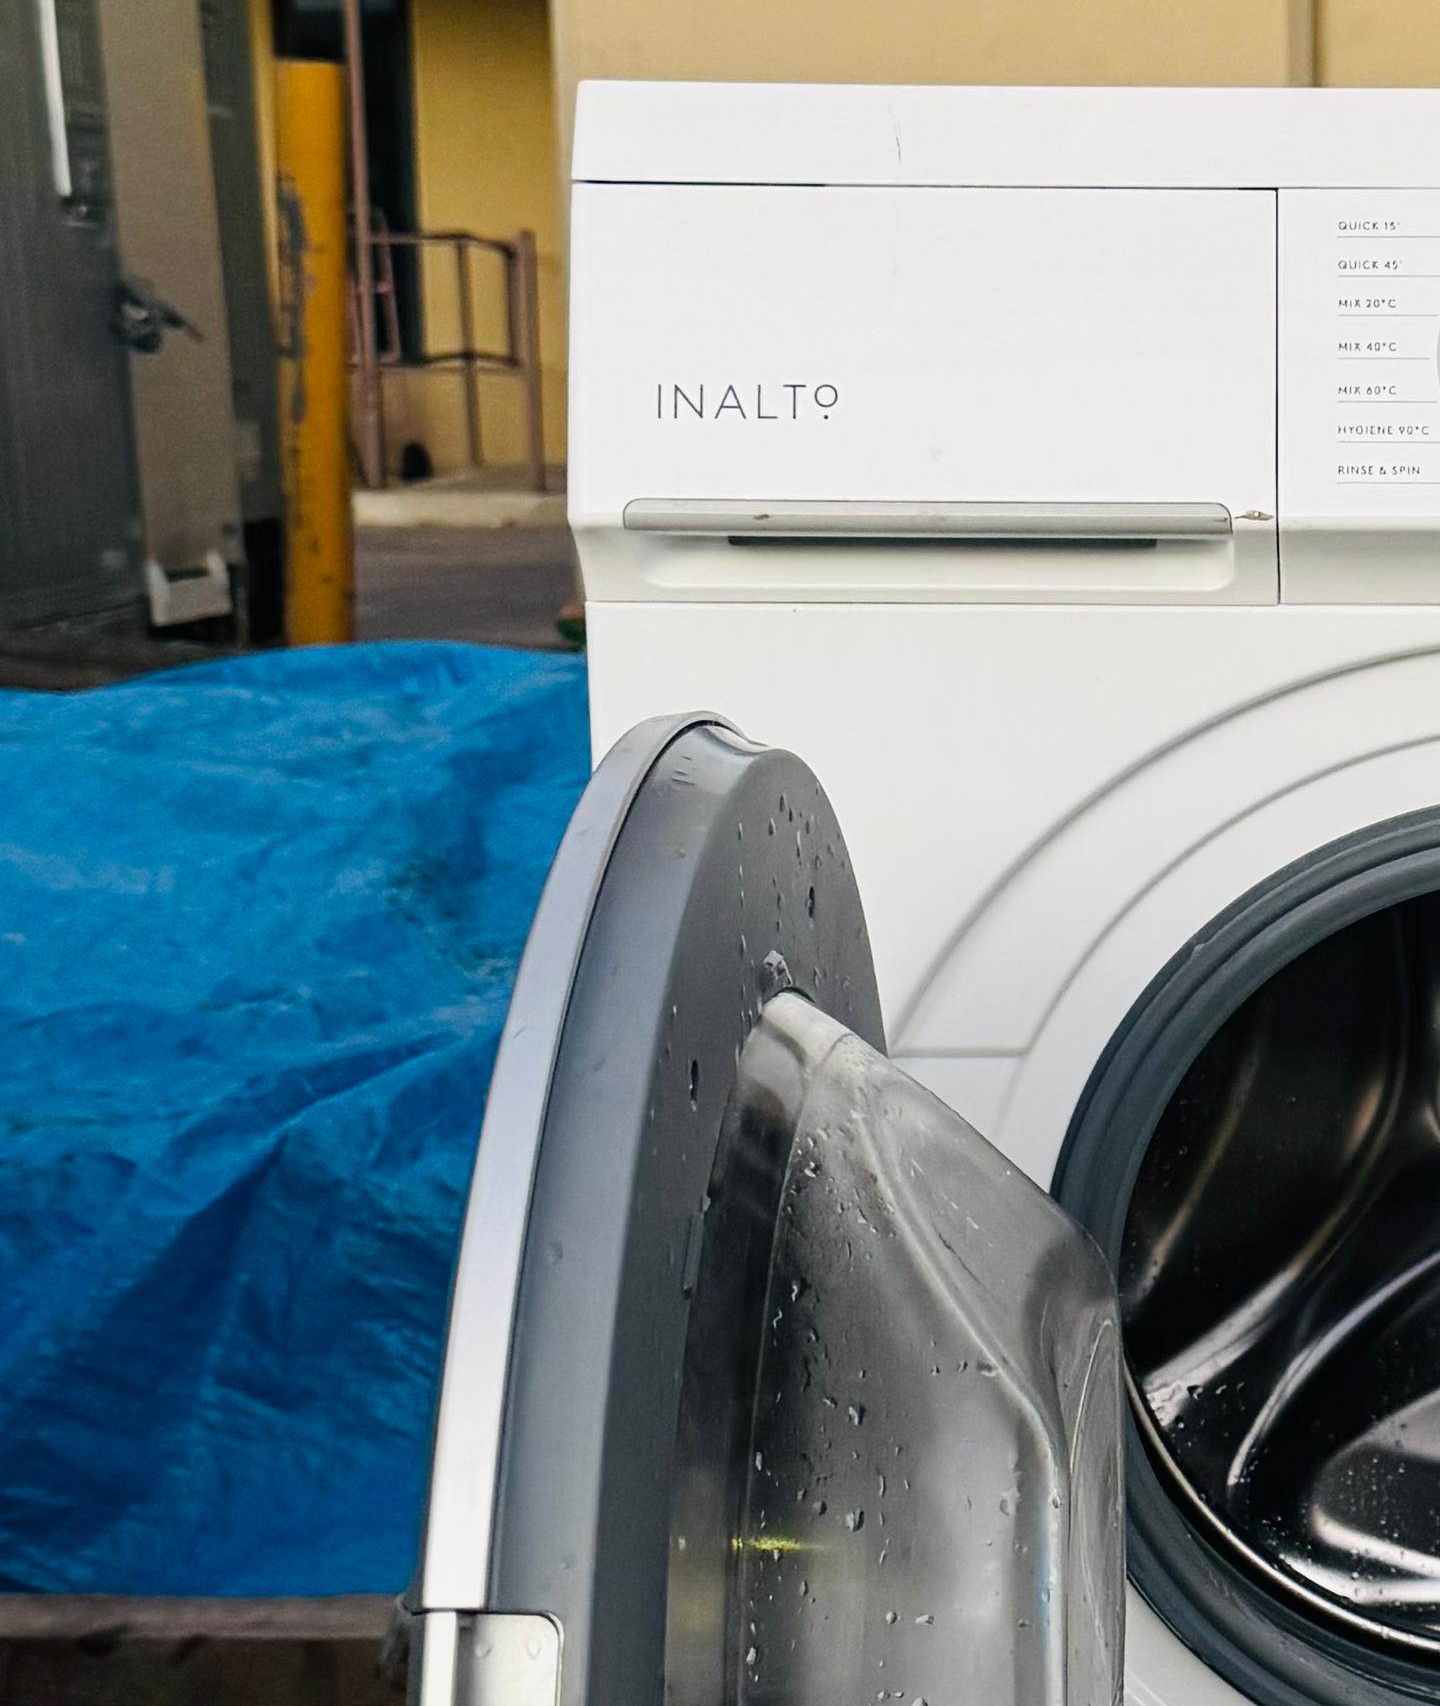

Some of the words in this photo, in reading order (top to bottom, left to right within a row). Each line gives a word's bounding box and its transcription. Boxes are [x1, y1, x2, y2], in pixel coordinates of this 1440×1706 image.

[1337, 221, 1379, 231] QUICK
[1337, 260, 1379, 270] QUICK
[1337, 299, 1362, 309] MIX
[1365, 299, 1397, 309] 20°C
[1337, 342, 1362, 352] MIX
[1365, 342, 1398, 352] 40°C
[1337, 386, 1362, 396] MIX
[1365, 386, 1397, 396] 60°C
[657, 383, 839, 420] INALTO
[1337, 425, 1393, 436] HYGIENE
[1398, 425, 1431, 436] 90°C
[1337, 465, 1375, 476] RINSE
[1378, 466, 1388, 476] &
[1392, 465, 1421, 476] SPIN
